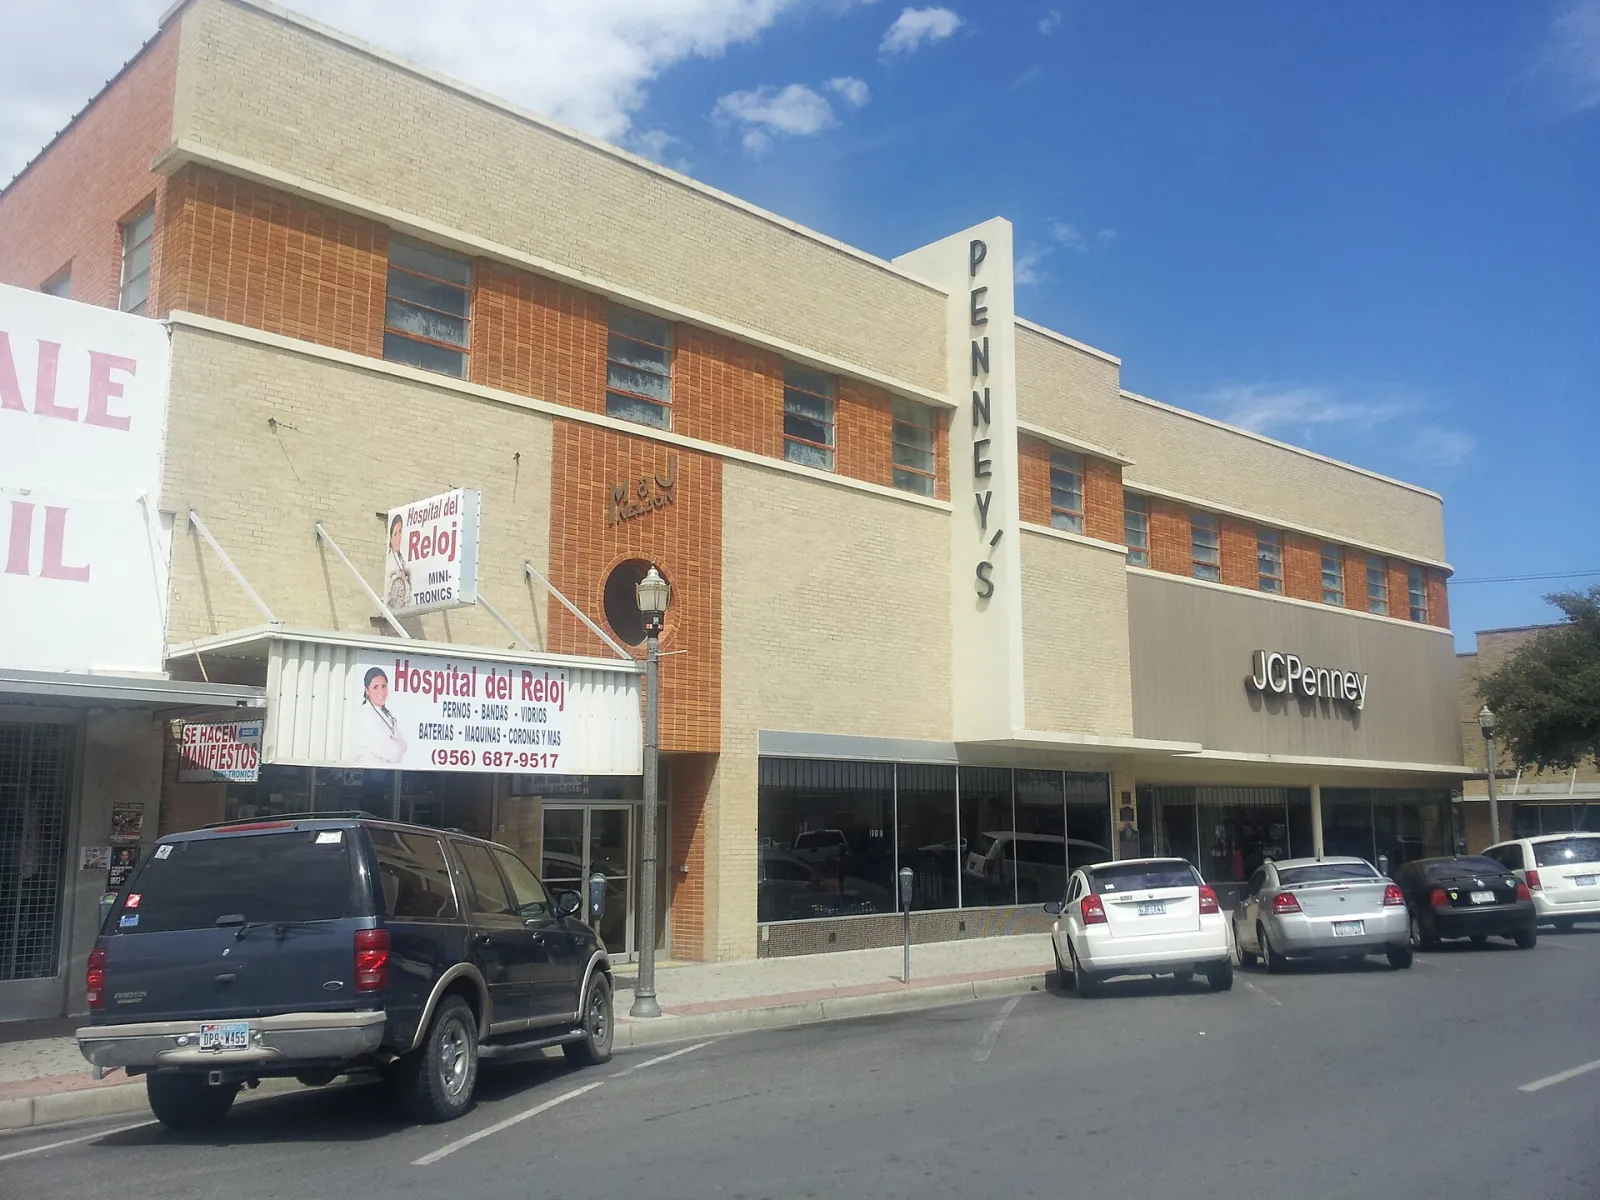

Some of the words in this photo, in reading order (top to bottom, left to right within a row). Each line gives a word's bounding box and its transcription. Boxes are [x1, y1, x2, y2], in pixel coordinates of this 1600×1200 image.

[970, 239, 1003, 600] PENNEY'S
[655, 455, 676, 487] J
[406, 499, 443, 527] Hospital
[443, 495, 459, 517] del
[408, 521, 457, 562] Reloj
[428, 570, 452, 585] MINI-
[414, 587, 452, 605] TRONICS
[394, 658, 477, 703] Hospital
[485, 667, 513, 700] del
[521, 670, 565, 712] Reloj
[1252, 650, 1368, 710] JCPenney
[442, 701, 471, 719] PERNOS
[481, 703, 509, 721] BANDAS
[521, 706, 547, 723] VIDRIOS
[184, 726, 197, 744] SE
[199, 725, 237, 743] HACEN
[418, 723, 454, 741] BATERIAS
[464, 725, 501, 743] MAQUINAS
[508, 727, 540, 746] CORONAS
[541, 730, 547, 745] Y
[547, 730, 561, 746] MAS
[182, 743, 258, 769] MANIFIESTOS
[431, 749, 476, 766] (956)
[482, 751, 559, 768] 687-9517
